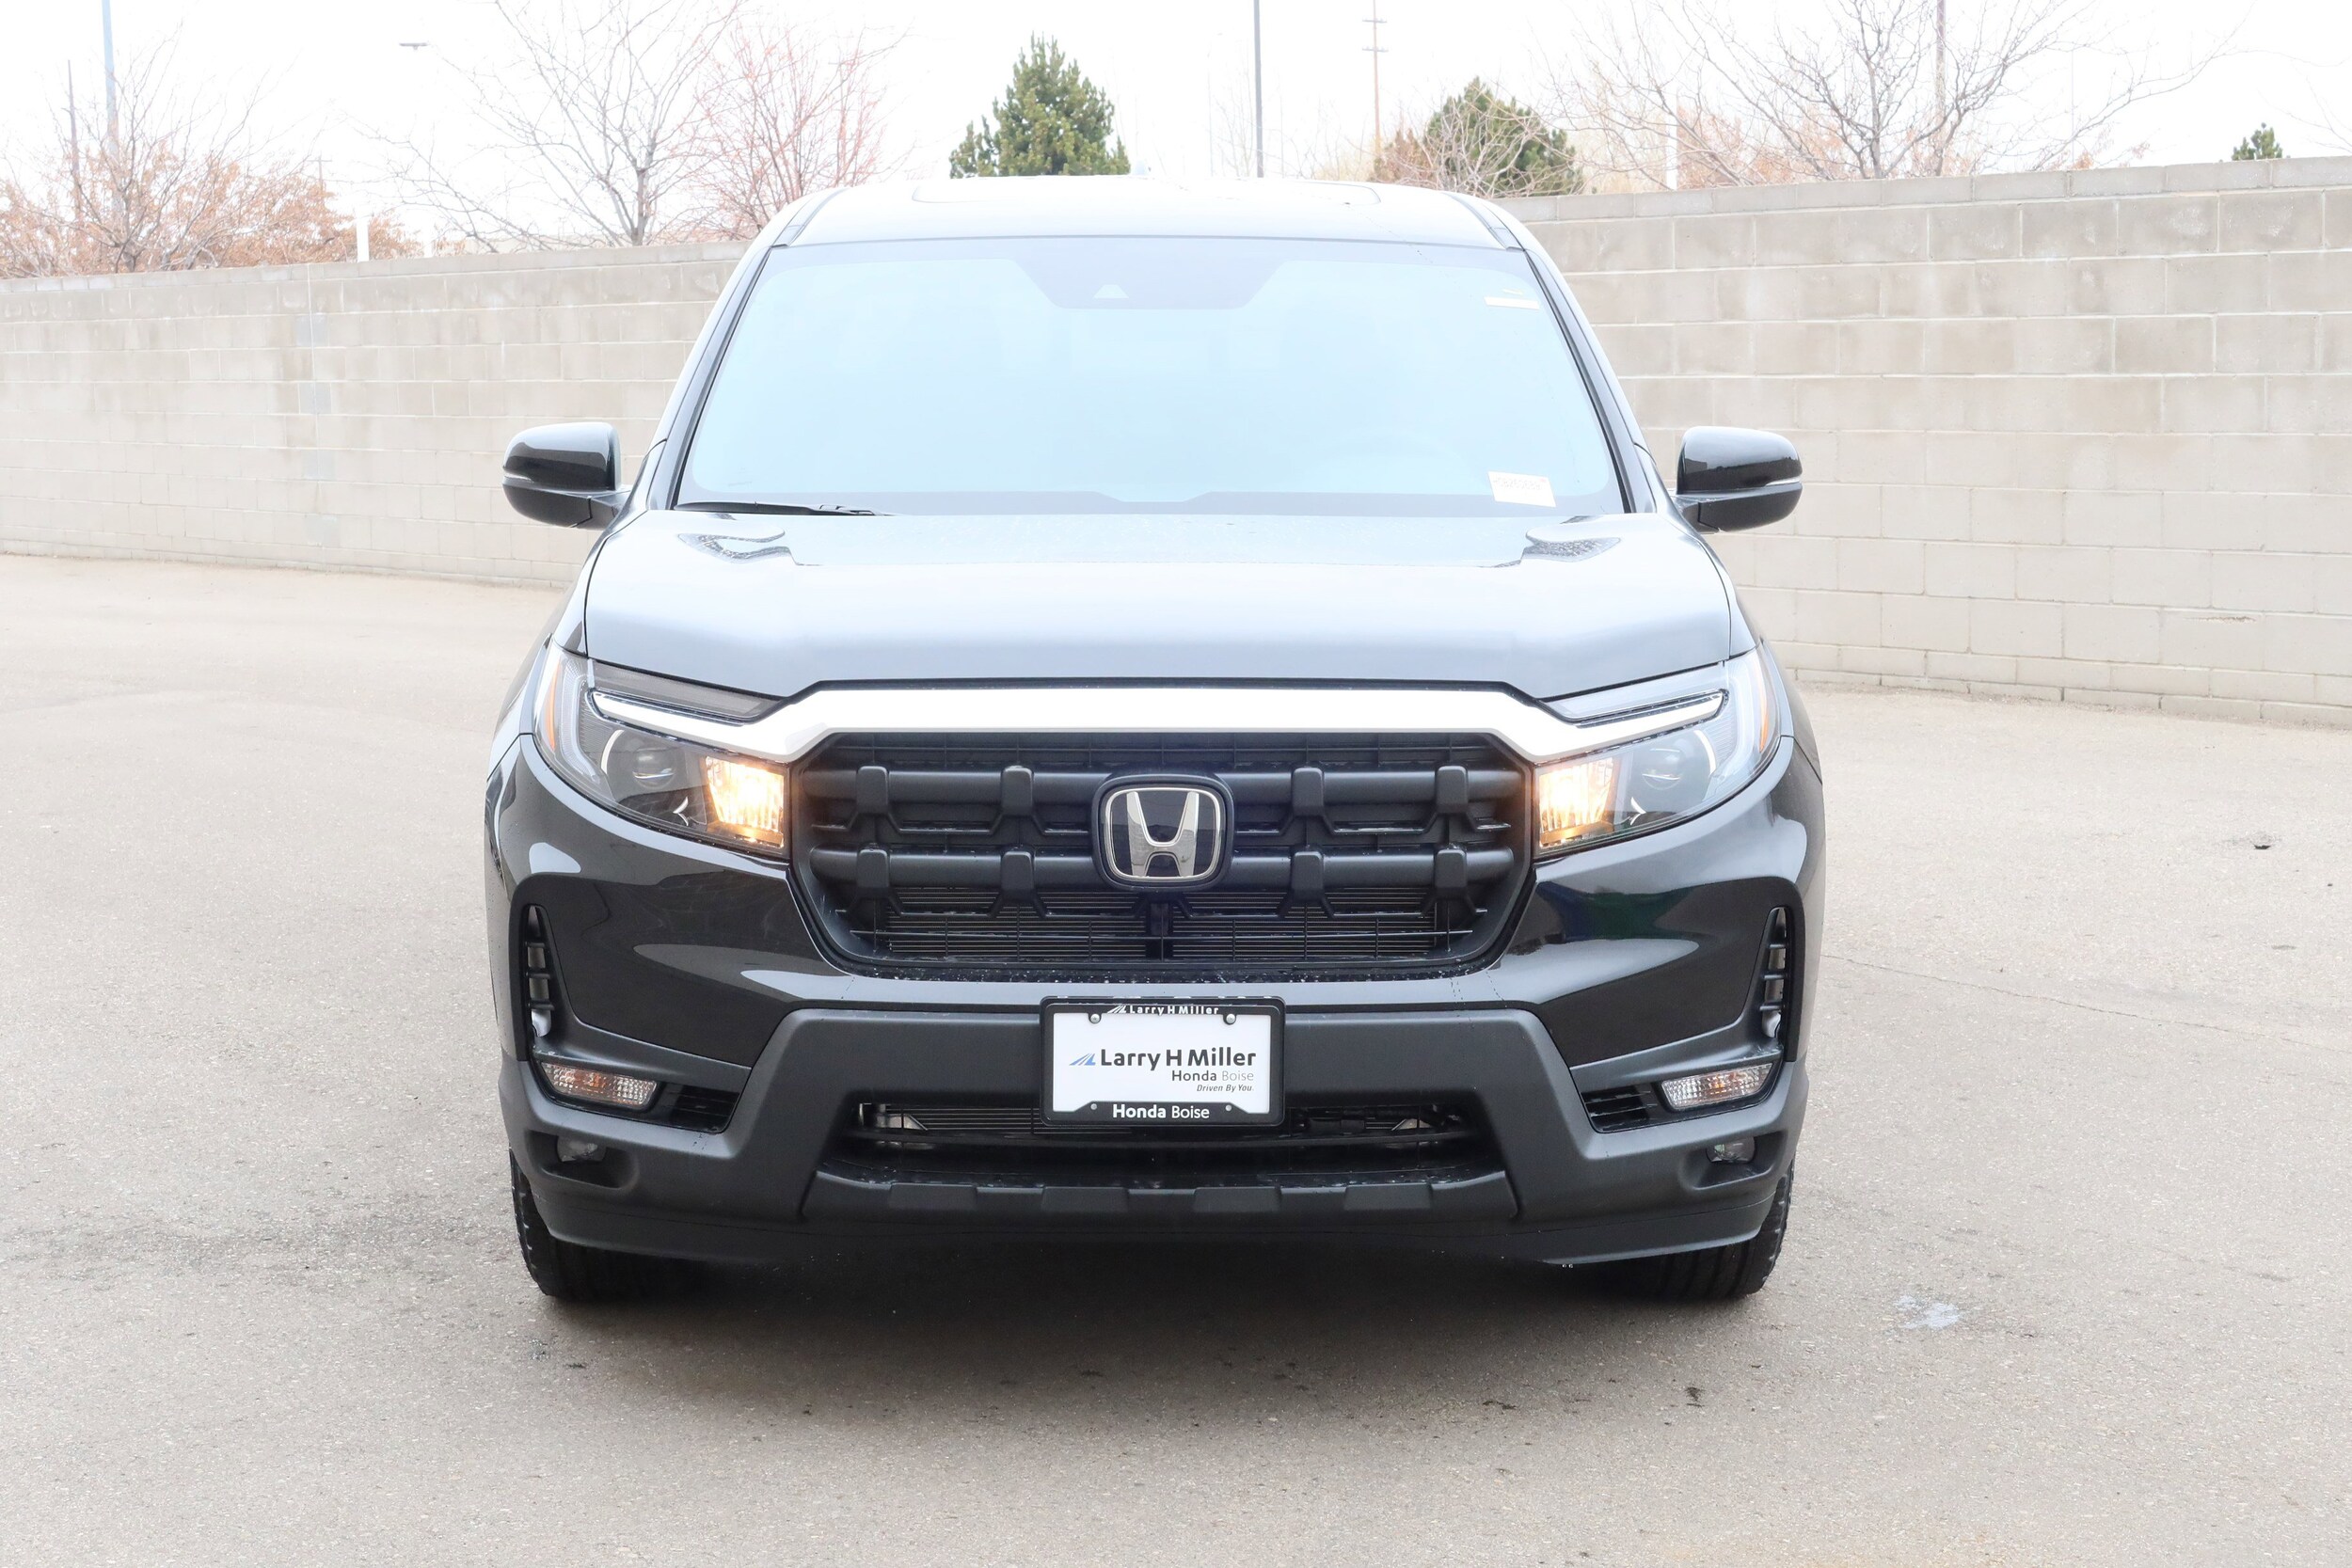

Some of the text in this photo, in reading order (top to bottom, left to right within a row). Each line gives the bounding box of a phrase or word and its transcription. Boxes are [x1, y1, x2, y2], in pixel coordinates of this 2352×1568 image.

[1130, 1005, 1219, 1016] Larry H Miller
[1101, 1046, 1256, 1070] Larry H Miller
[1171, 1069, 1254, 1082] Honda Boise
[1197, 1084, 1223, 1092] Driven
[1226, 1084, 1236, 1093] By
[1112, 1103, 1210, 1119] Honda Boise
